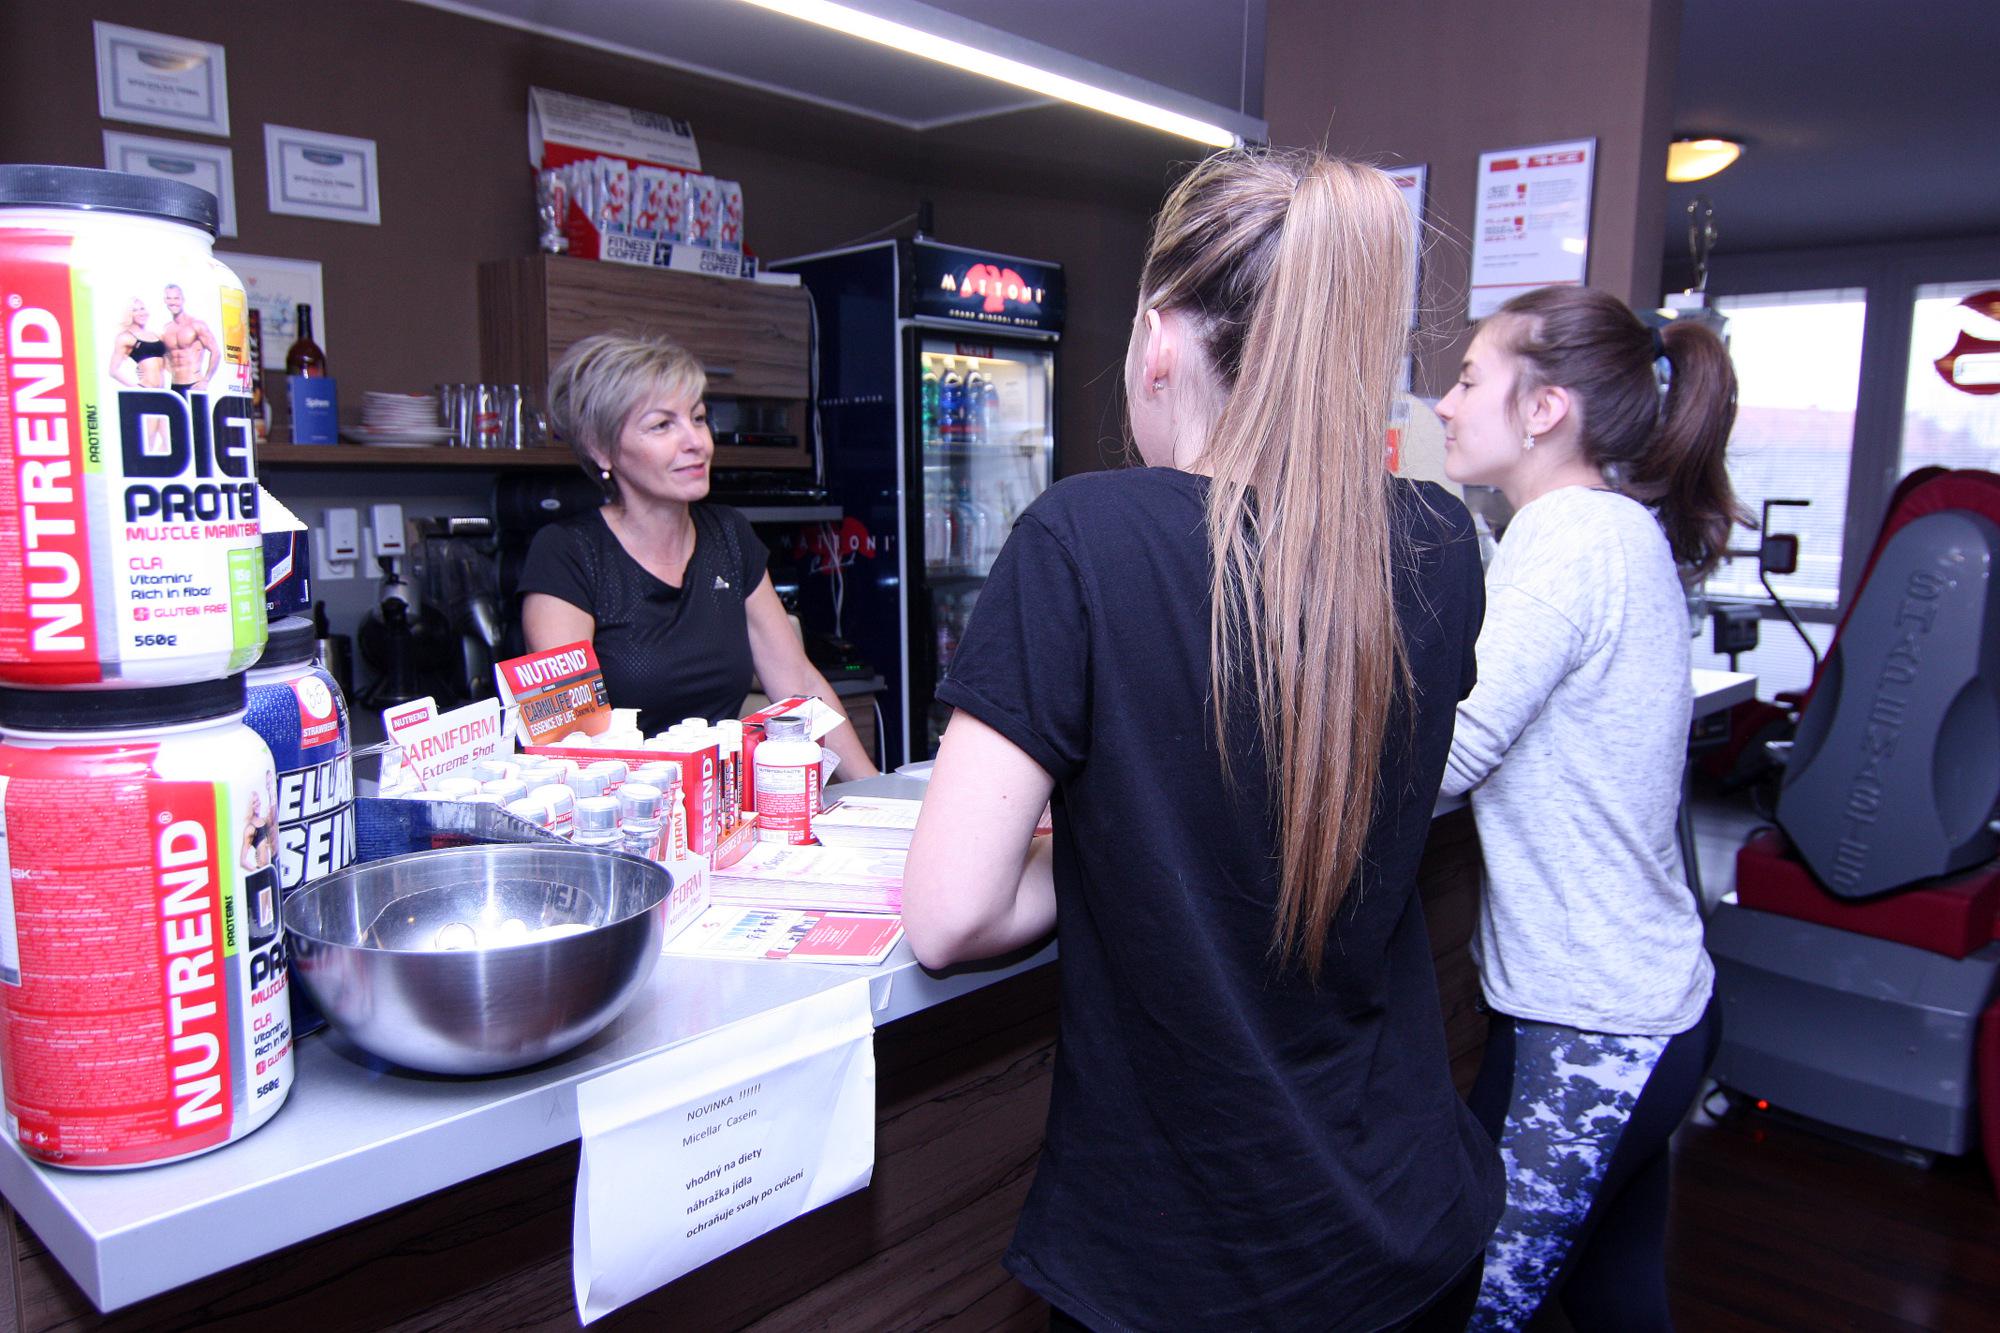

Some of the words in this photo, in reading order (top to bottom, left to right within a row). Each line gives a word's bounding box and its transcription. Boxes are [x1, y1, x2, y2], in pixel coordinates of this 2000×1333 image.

[607, 247, 650, 263] COFFEE
[608, 237, 651, 252] FITNESS
[700, 251, 738, 264] FITNESS
[699, 262, 737, 275] COFFEE
[941, 273, 1043, 304] MATTONI
[89, 403, 99, 464] PROTEINS
[118, 391, 259, 477] DIE
[8, 305, 86, 652] NUTREND
[126, 526, 200, 542] MUSCLE
[129, 557, 162, 570] CLA
[130, 573, 193, 585] Vitamins
[131, 589, 163, 600] Rich
[167, 588, 180, 599] in
[184, 586, 212, 598] fiber
[154, 605, 200, 618] GLUTEN
[203, 603, 228, 614] FREE
[135, 634, 178, 647] 560g
[514, 648, 588, 688] NUTREND
[393, 710, 428, 728] NUTREND
[530, 719, 556, 737] ESSENCE
[555, 717, 564, 729] OF
[562, 710, 577, 726] LIFE
[422, 754, 469, 781] Extreme
[472, 743, 495, 762] Shot
[280, 760, 354, 822] ELLA
[702, 757, 714, 854] TREND
[280, 802, 357, 887] SEIN
[225, 896, 235, 947] PROTEINS
[161, 821, 224, 1129] NUTREND
[254, 1013, 272, 1031] CLA
[255, 1043, 273, 1058] Rich
[257, 1077, 280, 1098] 560g
[686, 1096, 733, 1121] NOVINKA
[682, 1122, 722, 1147] Micellar
[726, 1108, 757, 1128] Casein
[685, 1164, 722, 1190] vhodný
[724, 1160, 736, 1173] na
[738, 1148, 762, 1166] diety
[686, 1186, 730, 1215] náhražka
[731, 1175, 752, 1193] jídla
[686, 1207, 735, 1238] ochraňuje
[736, 1194, 760, 1213] svaly
[760, 1187, 773, 1202] po
[774, 1168, 804, 1192] cvičení
